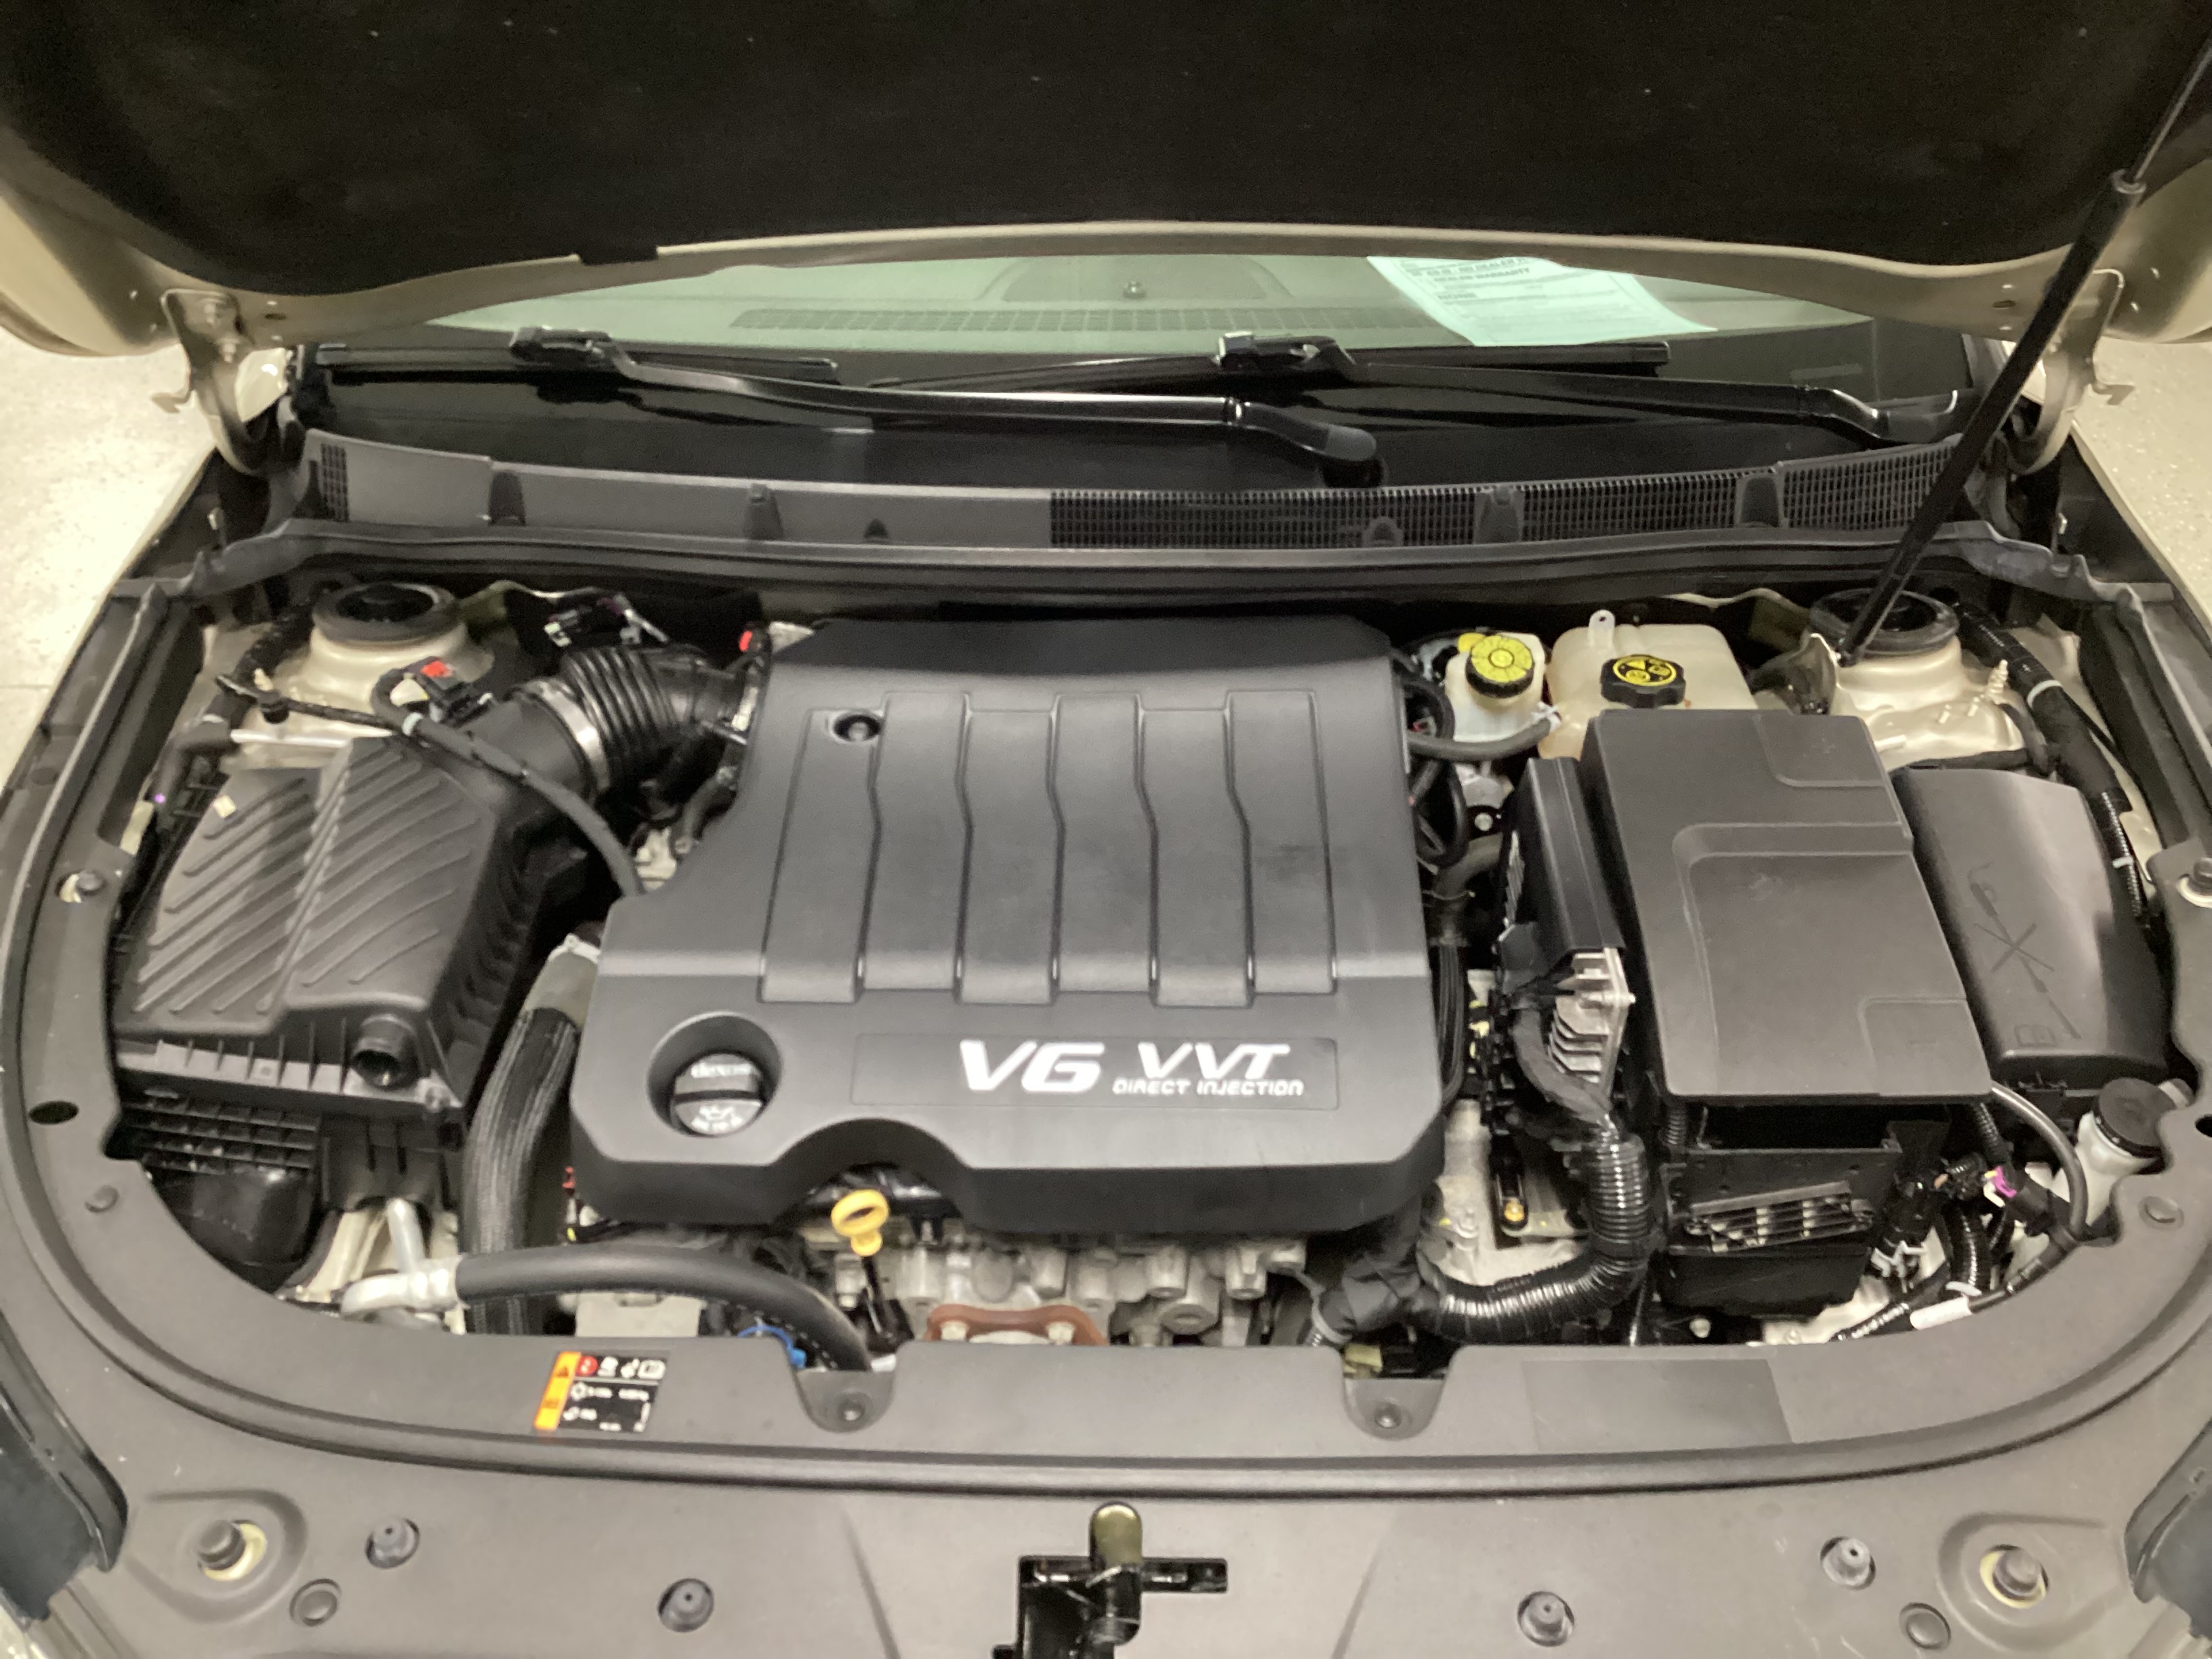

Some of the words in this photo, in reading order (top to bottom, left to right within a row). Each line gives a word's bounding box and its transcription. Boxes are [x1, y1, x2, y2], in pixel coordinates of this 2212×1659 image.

[959, 1039, 1105, 1093] V6
[1137, 1042, 1291, 1080] VVT
[1111, 1077, 1191, 1095] DIRECT
[1195, 1078, 1305, 1097] INJECTION
